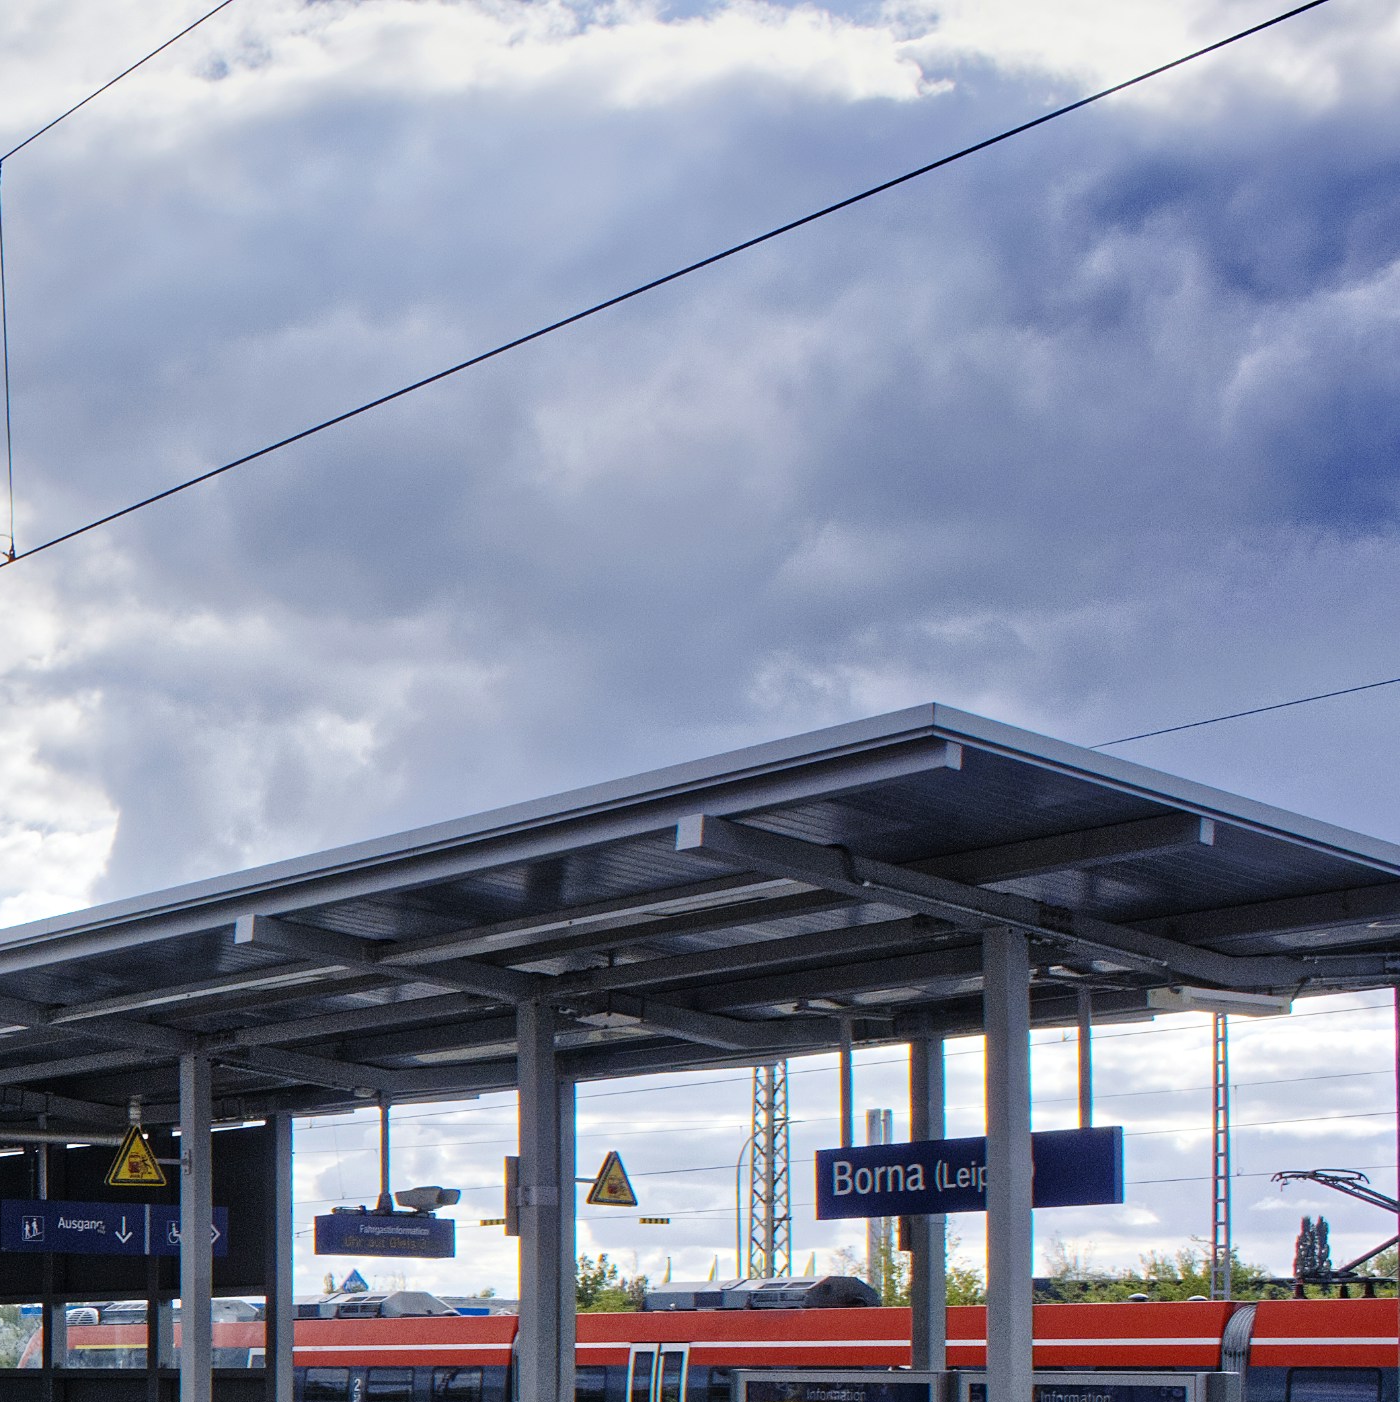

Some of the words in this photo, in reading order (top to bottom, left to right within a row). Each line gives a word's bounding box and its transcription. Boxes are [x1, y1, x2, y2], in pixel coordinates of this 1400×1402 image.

[833, 1161, 924, 1196] Borna
[360, 1224, 429, 1236] Fahrgastinformation
[354, 1378, 362, 1392] 2
[806, 1388, 867, 1401] Information
